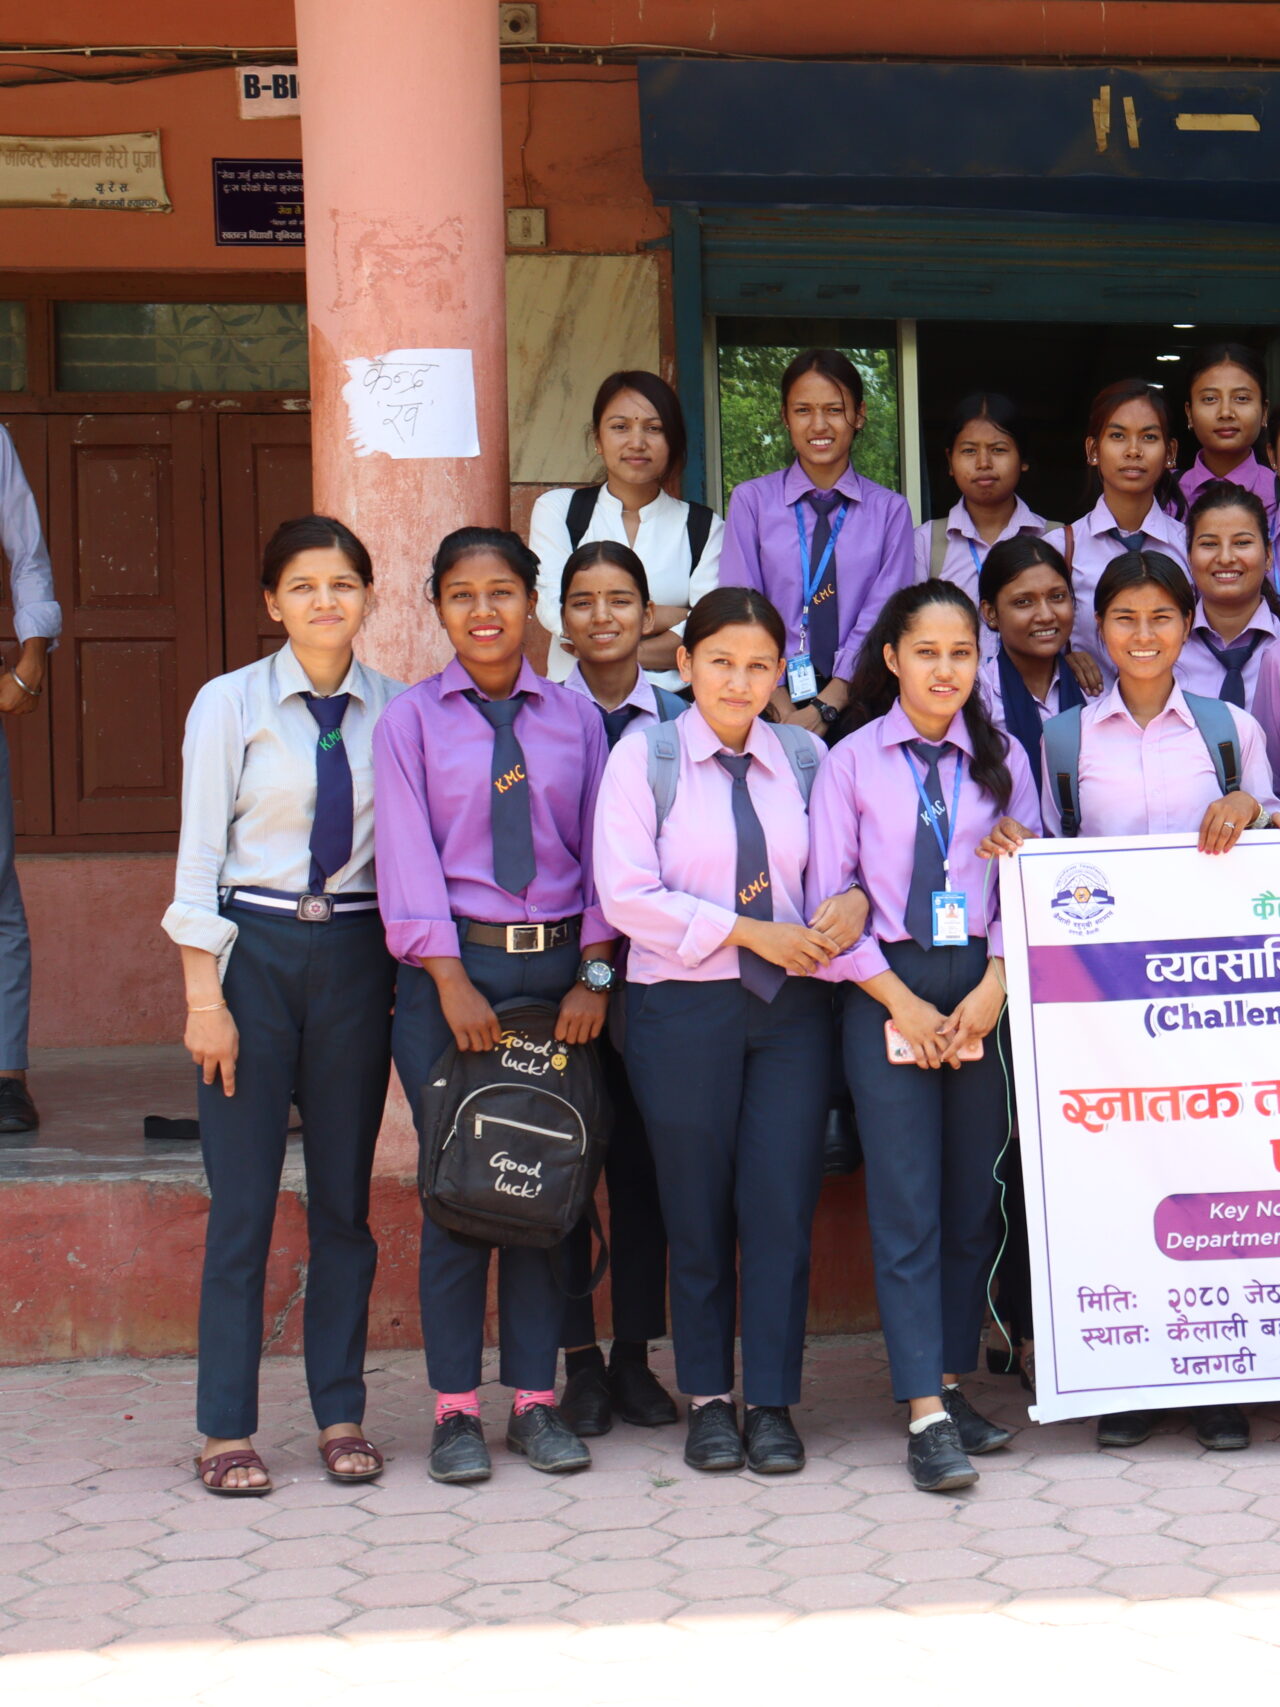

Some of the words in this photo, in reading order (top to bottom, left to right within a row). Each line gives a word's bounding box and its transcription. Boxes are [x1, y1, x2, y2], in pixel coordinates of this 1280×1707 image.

[243, 74, 299, 99] B-BI
[132, 150, 158, 173] पूजा
[813, 583, 836, 605] KMC
[494, 764, 525, 793] KMC
[738, 871, 769, 905] KMC
[499, 1030, 551, 1056] Good
[501, 1050, 549, 1076] luck!
[1058, 1080, 1243, 1133] स्नातक
[489, 1151, 541, 1178] Good
[494, 1174, 542, 1199] luck!
[1209, 1201, 1249, 1223] Key
[1168, 1286, 1230, 1314] २०८०
[1166, 1313, 1248, 1343] कैलाली
[1171, 1346, 1256, 1376] धनगढी
